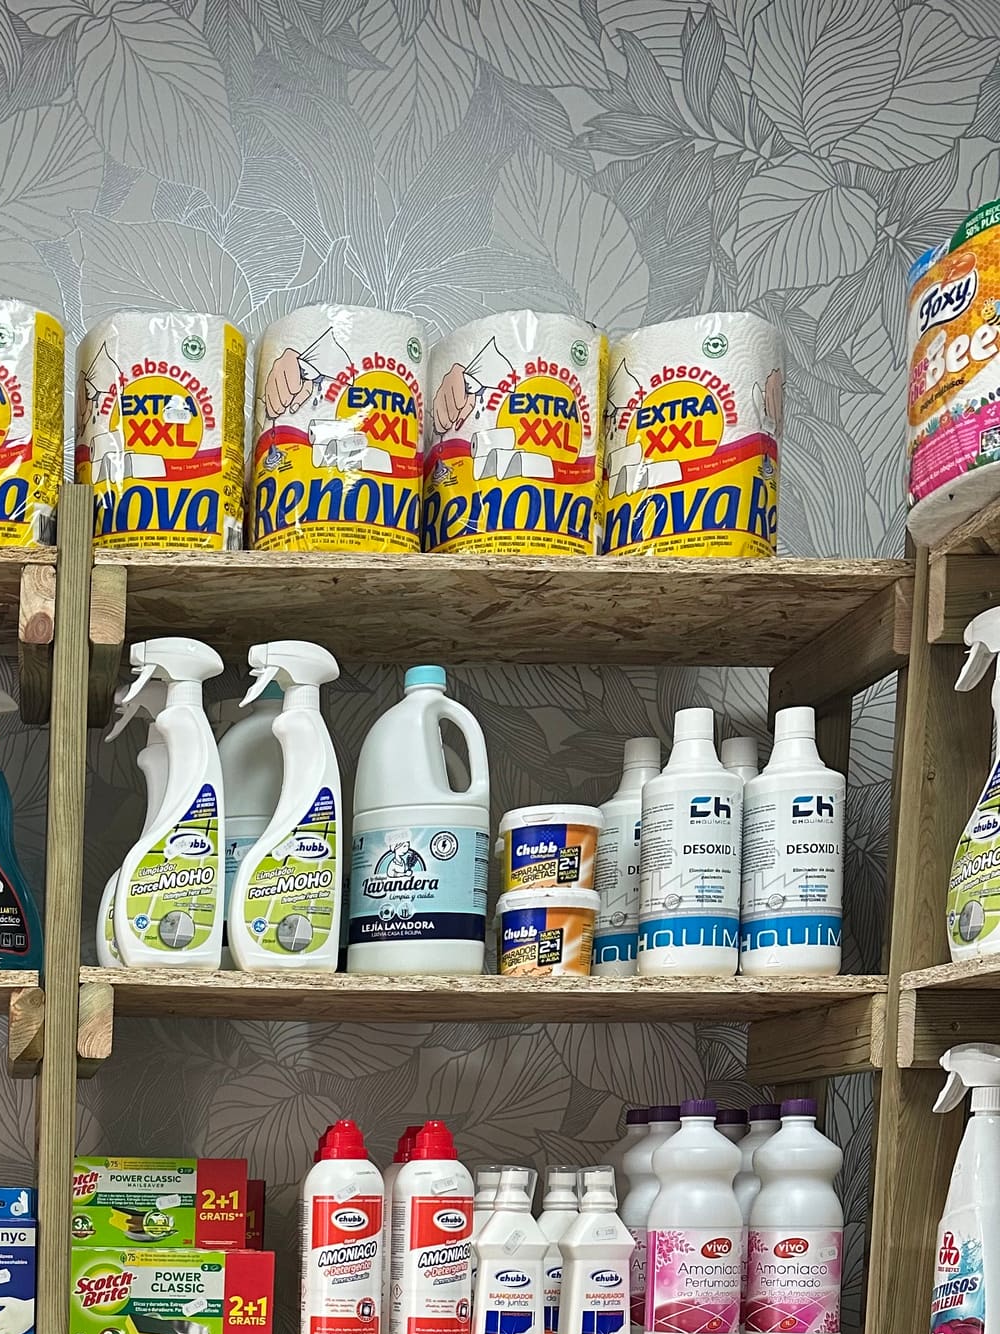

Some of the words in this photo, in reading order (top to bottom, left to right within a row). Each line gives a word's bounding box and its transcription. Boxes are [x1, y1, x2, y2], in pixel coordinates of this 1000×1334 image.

[920, 276, 972, 331] Foxy
[324, 363, 357, 403] max
[348, 386, 416, 418] EXTRA
[486, 370, 520, 412] max
[525, 357, 591, 438] absorption
[618, 387, 648, 430] max
[650, 366, 737, 425] absorption
[509, 394, 579, 422] EXTRA
[636, 397, 718, 430] EXTRA
[360, 413, 416, 450] XXL
[519, 418, 578, 453] XXL
[645, 422, 717, 458] XXL
[422, 486, 593, 553] Renova
[516, 842, 557, 856] Chubb
[683, 845, 732, 855] DESOXID
[786, 844, 835, 854] DESOXID
[131, 882, 159, 896] Force
[158, 866, 214, 890] MOHO
[249, 886, 277, 899] Force
[276, 871, 331, 894] MOHO
[522, 870, 556, 884] GRIETAS
[362, 878, 438, 898] Lavandera
[361, 921, 382, 932] LEJÍA
[384, 922, 434, 931] LAVADORA
[504, 927, 537, 942] Chubb
[144, 1175, 181, 1183] CLASSIC
[202, 1190, 238, 1210] 2+1
[338, 1216, 364, 1224] chubb
[319, 1242, 376, 1266] AMONIACO
[155, 1272, 201, 1282] POWER
[501, 1275, 527, 1283] chubb
[756, 1264, 828, 1276] Amoniaco
[151, 1283, 204, 1293] CLASSIC
[761, 1277, 820, 1288] Perfumado
[83, 1287, 128, 1308] Brite
[229, 1297, 267, 1316] 2+1
[229, 1316, 266, 1325] GRATIS
